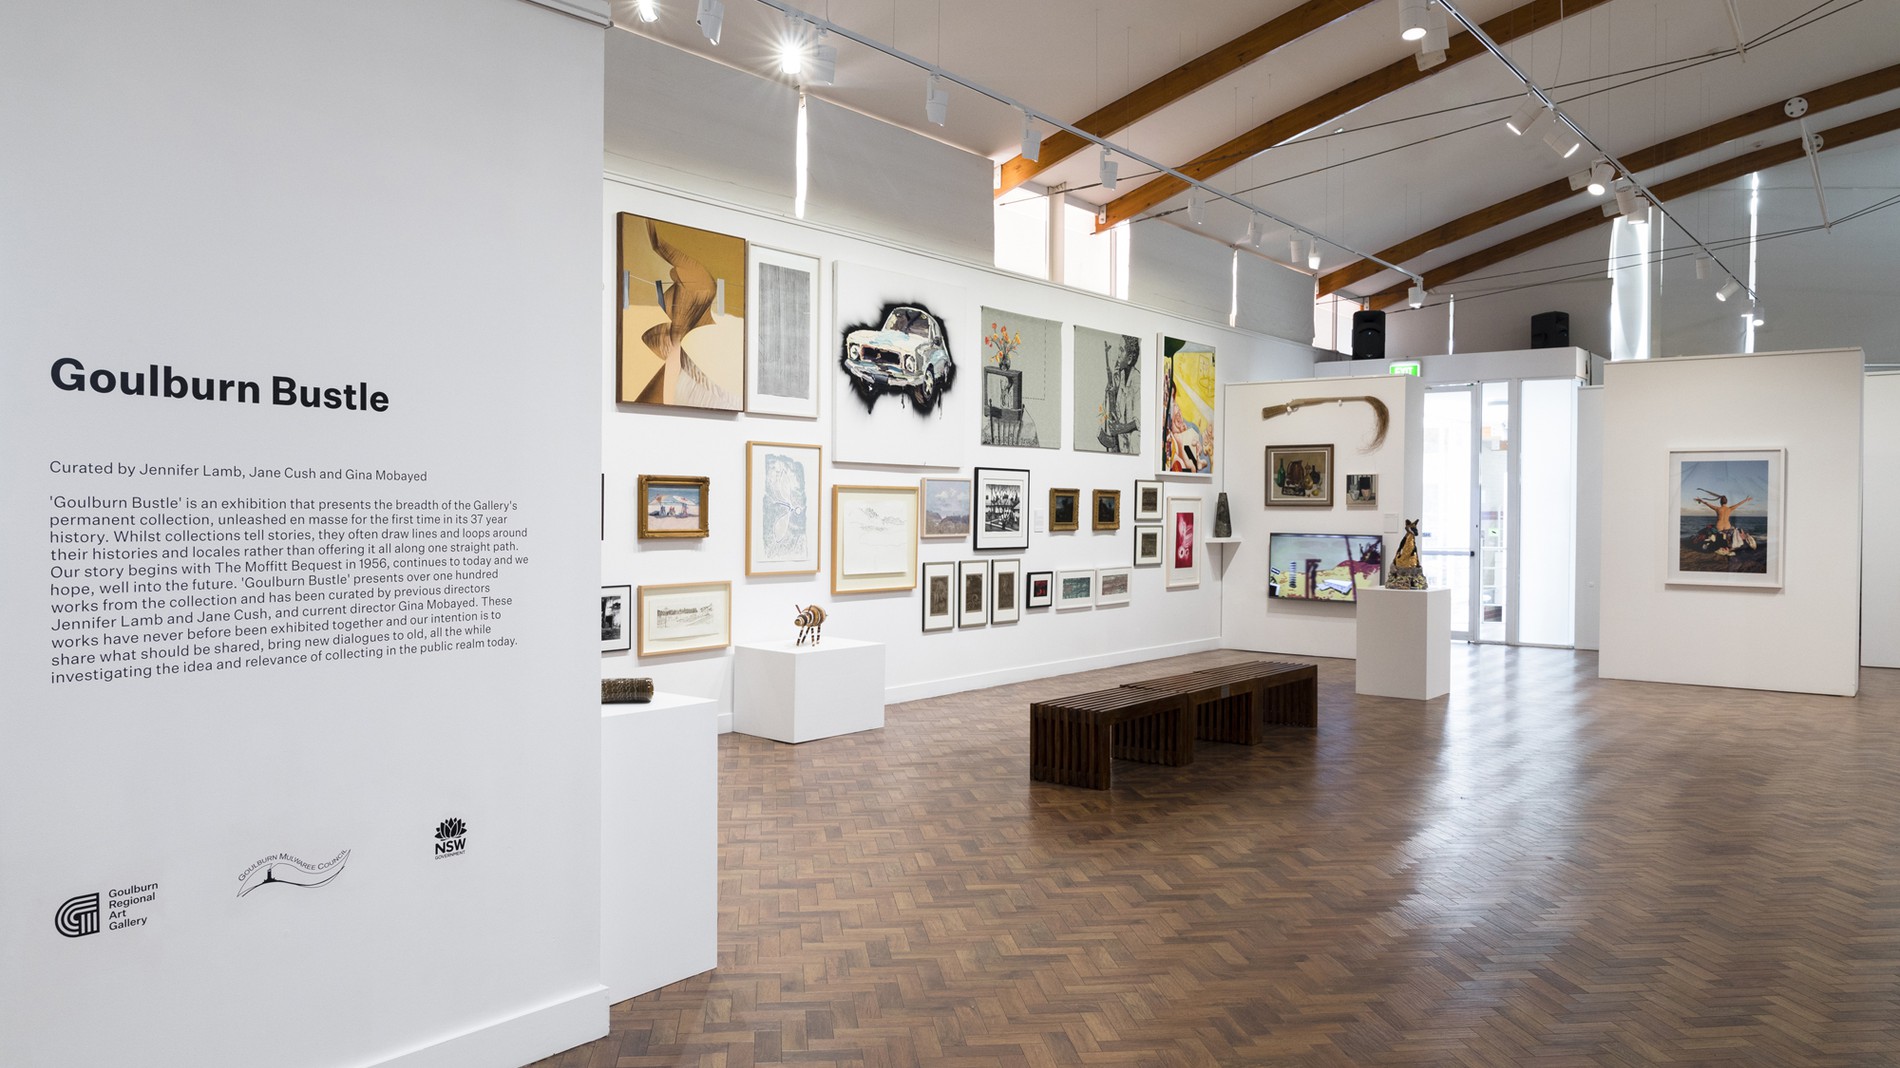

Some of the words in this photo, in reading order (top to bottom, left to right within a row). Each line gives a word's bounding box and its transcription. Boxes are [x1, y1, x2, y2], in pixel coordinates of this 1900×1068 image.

[50, 357, 260, 404] Goulburn
[272, 375, 389, 412] Bustle
[50, 460, 113, 474] Curated
[118, 462, 136, 477] by
[139, 463, 200, 476] Jennifer
[203, 465, 245, 479] Lamb,
[249, 466, 281, 478] Jane
[284, 467, 316, 479] Cush
[319, 468, 342, 480] and
[345, 468, 372, 480] Gina
[376, 470, 427, 483] Mobayed
[50, 495, 127, 509] 'Goulburn
[132, 496, 182, 509] Bustle'
[186, 497, 197, 509] is
[201, 500, 217, 509] an
[221, 497, 287, 509] exhibition
[290, 498, 315, 510] that
[319, 500, 371, 512] presents
[374, 499, 393, 510] the
[396, 499, 439, 510] breadth
[441, 499, 452, 510] of
[454, 500, 471, 510] the
[473, 500, 518, 513] Gallery's
[50, 515, 136, 528] permanent
[139, 513, 214, 527] collection,
[218, 513, 286, 525] unleashed
[290, 516, 305, 525] en
[309, 516, 348, 525] masse
[351, 513, 368, 525] for
[370, 514, 389, 525] the
[391, 513, 414, 525] first
[416, 514, 441, 524] time
[443, 514, 453, 524] in
[455, 514, 468, 524] its
[470, 514, 483, 524] 37
[485, 516, 508, 526] year
[50, 530, 109, 546] history.
[113, 530, 161, 543] Whilst
[165, 530, 241, 542] collections
[244, 529, 264, 541] tell
[268, 529, 315, 542] stories,
[318, 529, 345, 542] they
[348, 528, 378, 540] often
[381, 528, 409, 539] draw
[412, 528, 438, 539] lines
[440, 528, 460, 539] and
[462, 528, 490, 540] loops
[492, 527, 527, 538] around
[51, 548, 88, 561] their
[93, 547, 158, 560] histories
[162, 546, 188, 559] and
[192, 545, 240, 558] locales
[244, 545, 284, 557] rather
[286, 544, 315, 556] than
[318, 543, 365, 557] offering
[368, 543, 375, 554] it
[378, 543, 391, 554] all
[394, 543, 425, 556] along
[428, 544, 448, 553] one
[450, 541, 491, 554] straight
[493, 541, 519, 553] path.
[50, 565, 80, 579] Our
[84, 566, 124, 579] story
[128, 563, 178, 578] begins
[181, 562, 211, 574] with
[215, 561, 241, 573] The
[245, 560, 288, 572] Moffitt
[291, 560, 342, 573] Bequest
[346, 559, 356, 569] in
[359, 557, 390, 570] 1956,
[393, 557, 447, 568] continues
[449, 557, 460, 566] to
[462, 555, 492, 567] today
[494, 554, 513, 565] and
[515, 556, 529, 564] we
[50, 583, 94, 598] hope,
[99, 581, 129, 594] well
[134, 581, 162, 593] into
[165, 579, 189, 592] the
[192, 578, 237, 591] future.
[241, 576, 305, 588] 'Goulburn
[309, 573, 350, 586] Bustle'
[353, 573, 404, 586] presents
[406, 573, 431, 582] over
[433, 572, 453, 581] one
[455, 568, 498, 580] hundred
[51, 600, 99, 614] works
[102, 598, 138, 611] from
[142, 597, 166, 609] the
[169, 594, 237, 608] collection
[240, 592, 265, 605] and
[269, 592, 291, 603] has
[295, 590, 325, 602] been
[328, 587, 374, 600] curated
[377, 587, 391, 600] by
[394, 585, 441, 599] previous
[443, 584, 490, 595] directors
[51, 616, 117, 631] Jennifer
[121, 613, 163, 627] Lamb
[167, 611, 193, 625] and
[196, 611, 231, 623] Jane
[234, 608, 271, 621] Cush,
[275, 606, 299, 618] and
[302, 605, 347, 617] current
[350, 603, 396, 614] director
[398, 600, 424, 611] Gina
[427, 597, 478, 610] Mobayed.
[481, 596, 513, 606] These
[51, 634, 99, 649] works
[103, 633, 139, 645] have
[143, 631, 184, 643] never
[187, 626, 231, 640] before
[235, 625, 267, 637] been
[270, 619, 329, 634] exhibited
[332, 617, 384, 632] together
[386, 615, 407, 627] and
[410, 616, 429, 625] our
[431, 612, 478, 623] intention
[480, 610, 489, 620] is
[491, 611, 501, 620] to
[51, 653, 96, 666] share
[99, 649, 137, 662] what
[141, 644, 189, 660] should
[193, 644, 210, 656] be
[214, 639, 264, 654] shared,
[268, 638, 301, 651] bring
[305, 638, 330, 647] new
[332, 633, 390, 646] dialogues
[393, 631, 404, 641] to
[406, 628, 427, 640] old,
[430, 627, 442, 638] all
[445, 626, 462, 637] the
[464, 624, 491, 635] while
[51, 665, 152, 684] investigating
[156, 662, 179, 675] the
[183, 660, 213, 673] idea
[216, 656, 241, 670] and
[245, 654, 307, 667] relevance
[310, 650, 322, 662] of
[325, 647, 383, 661] collecting
[386, 645, 396, 656] in
[399, 644, 417, 655] the
[420, 641, 453, 655] public
[456, 638, 485, 650] realm
[487, 636, 518, 648] today.
[435, 838, 466, 855] NSW
[108, 883, 159, 898] Goulburn
[108, 892, 156, 909] Regional
[108, 910, 127, 920] Art
[108, 917, 148, 931] Gallery
